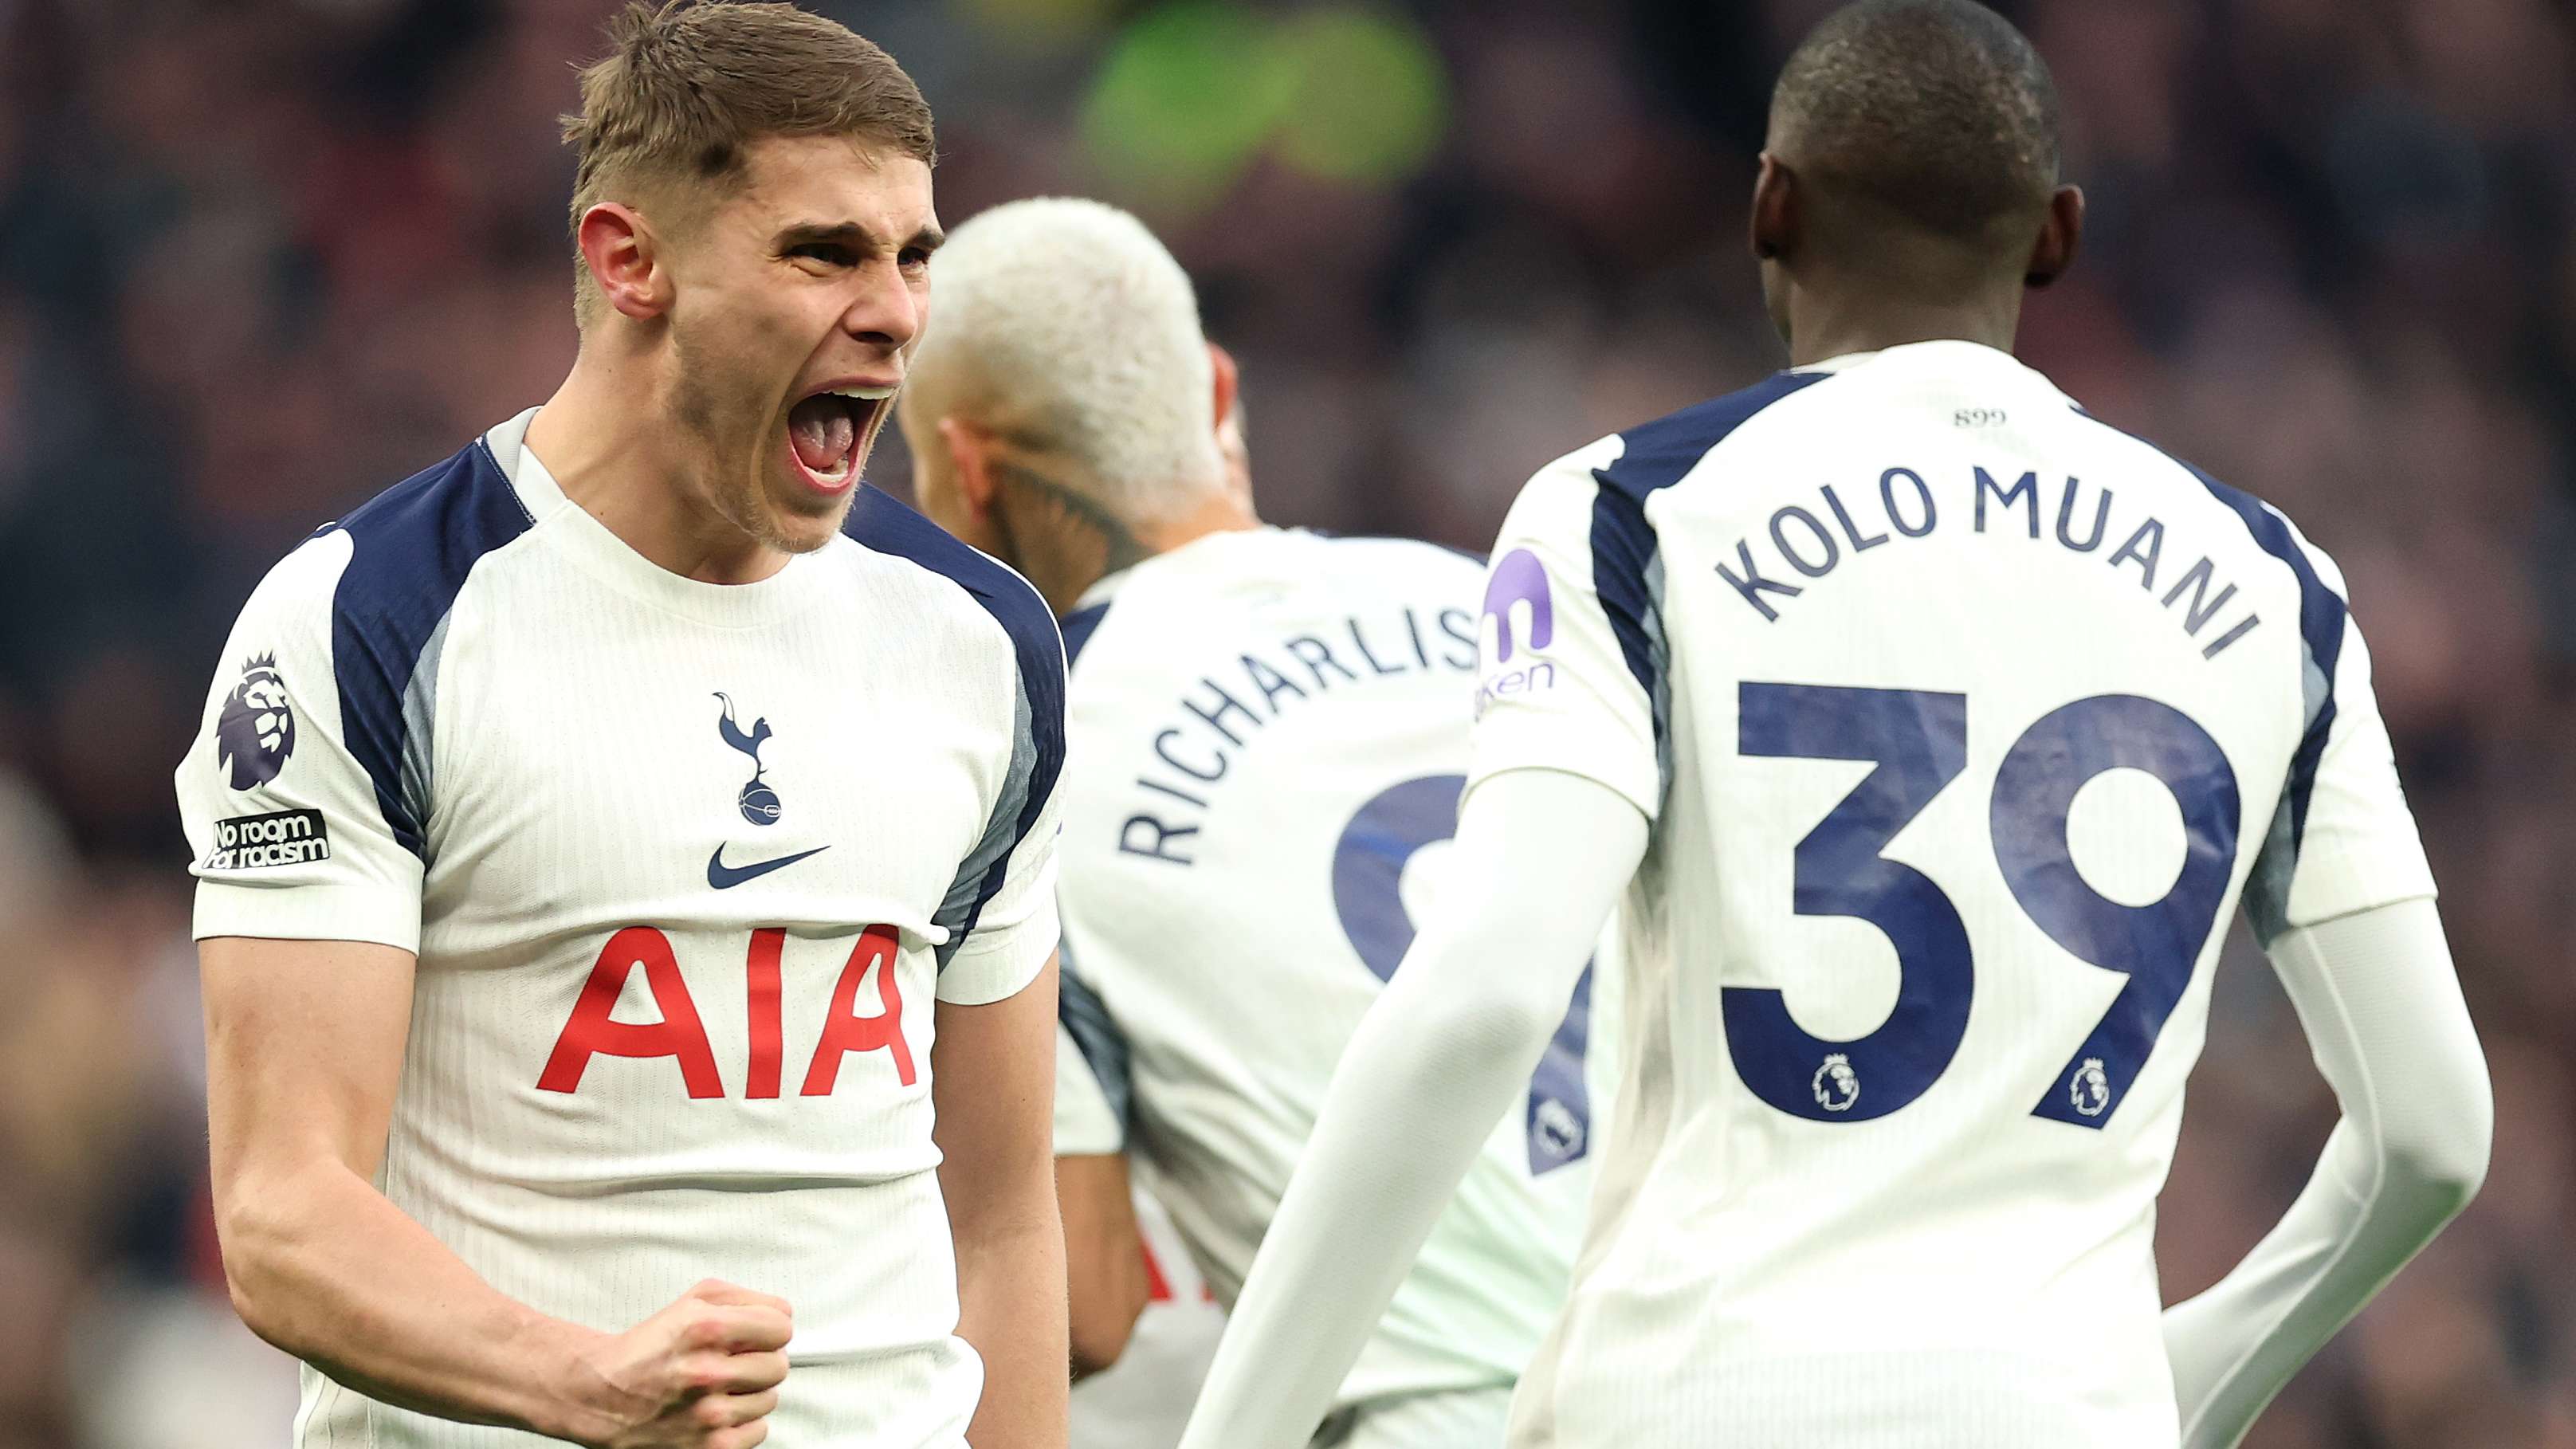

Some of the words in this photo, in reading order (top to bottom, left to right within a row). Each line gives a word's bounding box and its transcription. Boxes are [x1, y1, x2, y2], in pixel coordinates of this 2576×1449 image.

[1714, 466, 1938, 624] KOLO
[1972, 465, 2261, 661] MUANI
[1117, 607, 1478, 867] RICHARLIS
[214, 820, 238, 849] No
[240, 815, 312, 843] room
[238, 837, 329, 868] racism
[1720, 680, 2242, 1132] 39
[536, 924, 917, 1100] AIA
